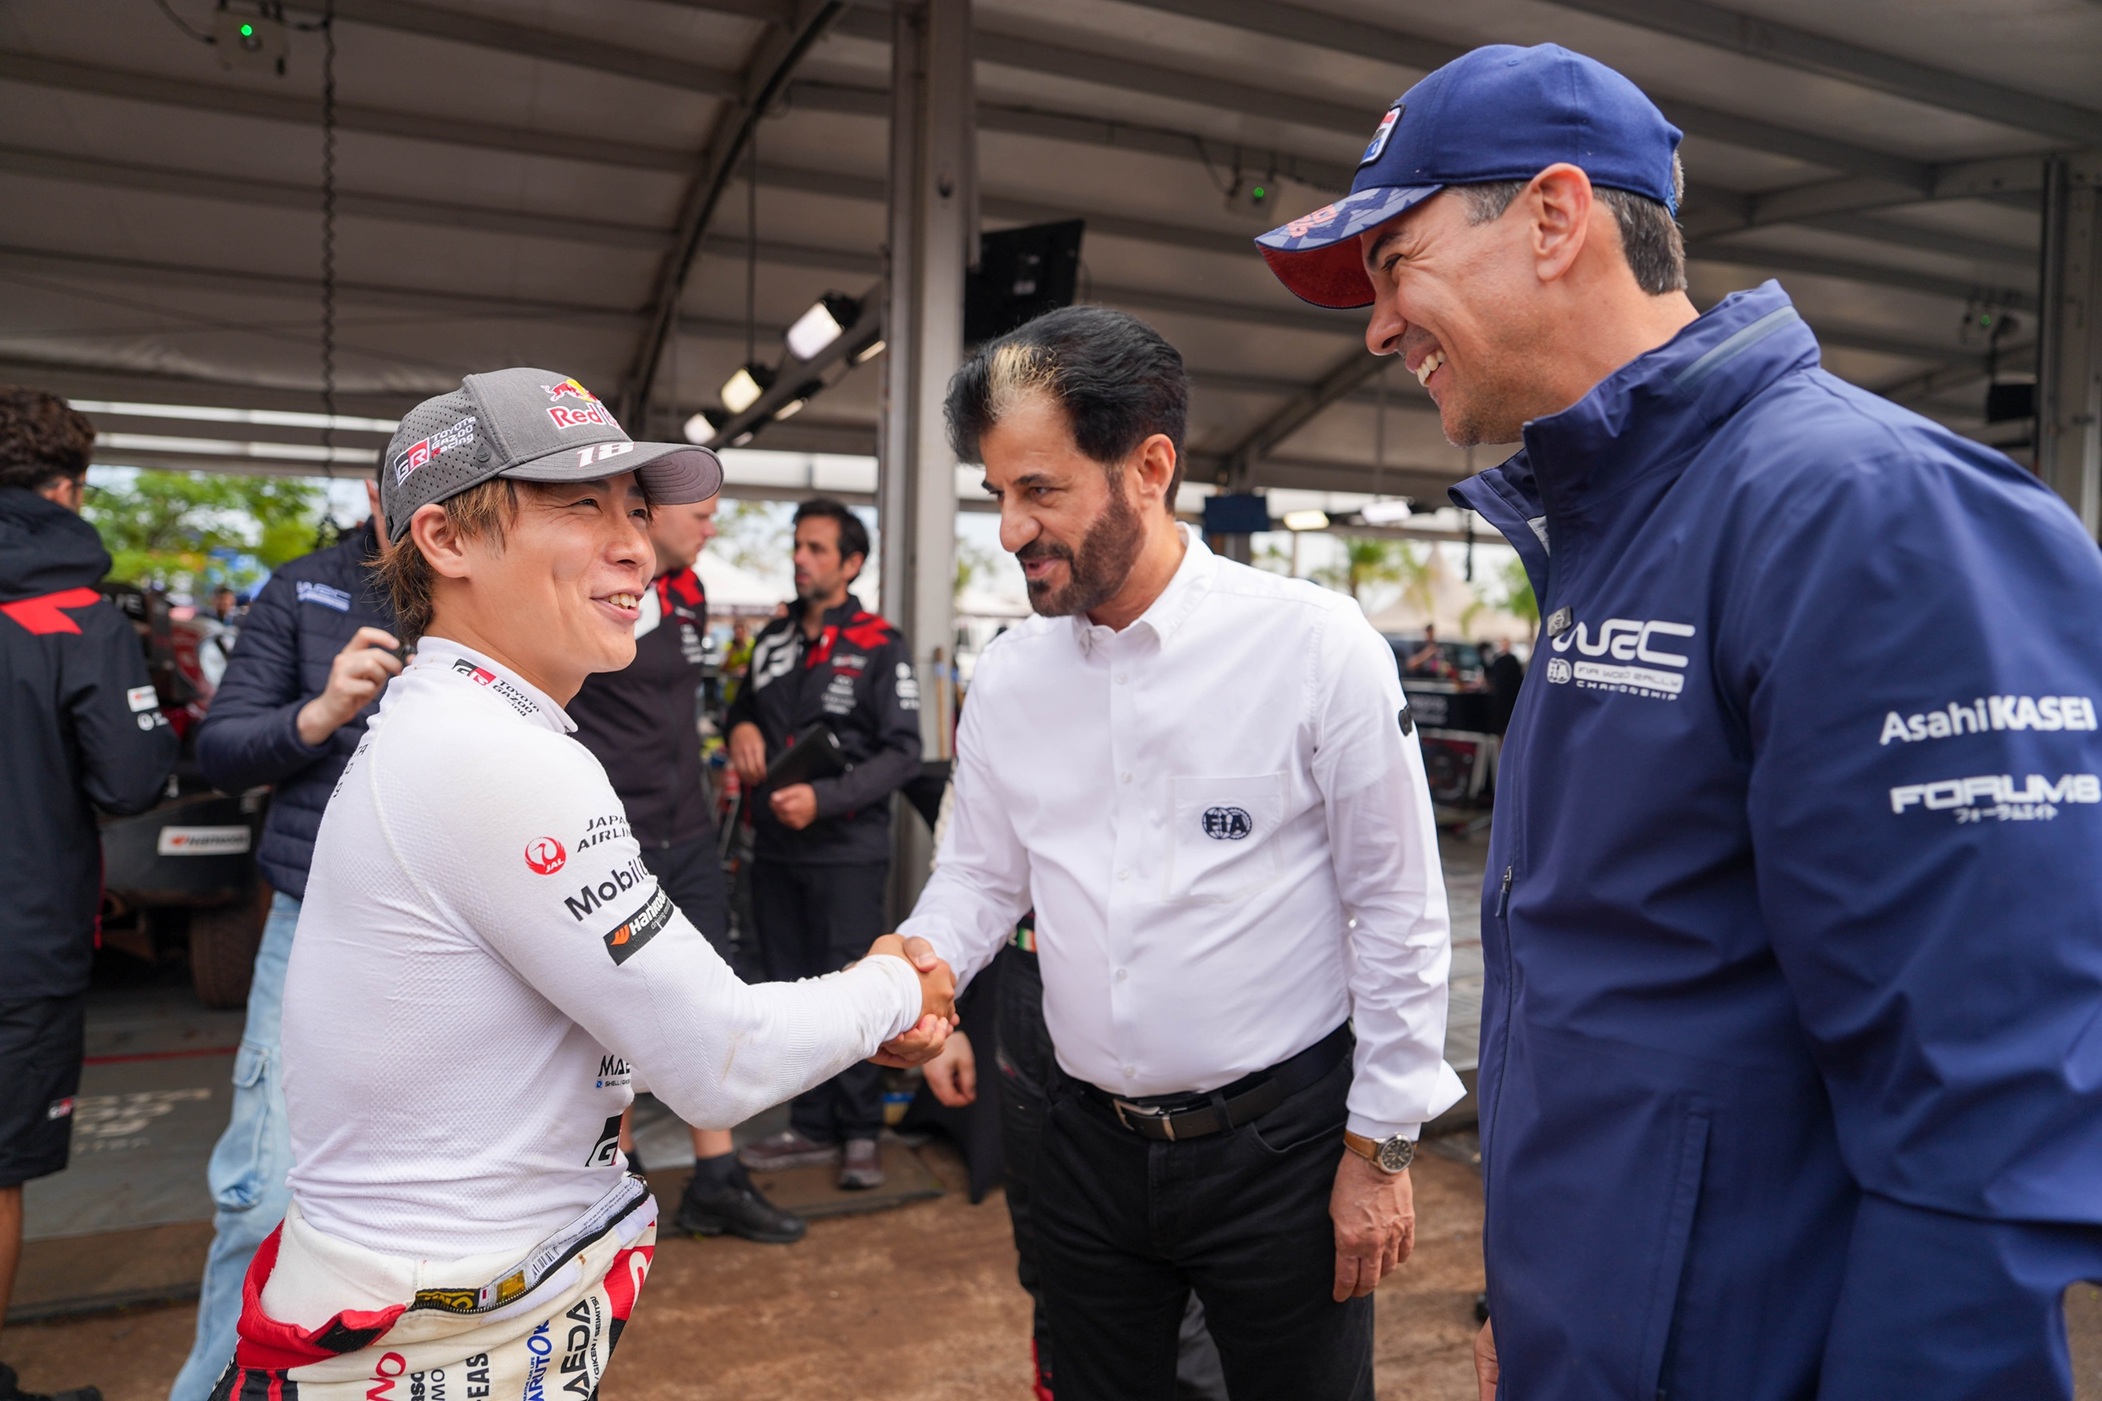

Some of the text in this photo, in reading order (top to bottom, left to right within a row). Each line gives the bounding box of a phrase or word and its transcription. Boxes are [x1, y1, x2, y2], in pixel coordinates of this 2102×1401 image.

[431, 416, 476, 442] TOYOTA
[547, 402, 606, 429] Red
[431, 424, 474, 450] GAZOO
[431, 433, 474, 458] Racing
[396, 442, 428, 483] GR
[577, 441, 634, 469] 18
[1552, 618, 1696, 668] WRC
[492, 684, 533, 713] GAZOO
[500, 680, 540, 712] TOYOTA
[1889, 773, 2102, 815] FORUM8
[586, 815, 629, 832] JAPA
[1205, 812, 1249, 834] FIA
[545, 858, 565, 873] JAL
[629, 888, 668, 936] Hankoo
[560, 1299, 591, 1399] AEDA
[466, 1352, 490, 1399] EAS
